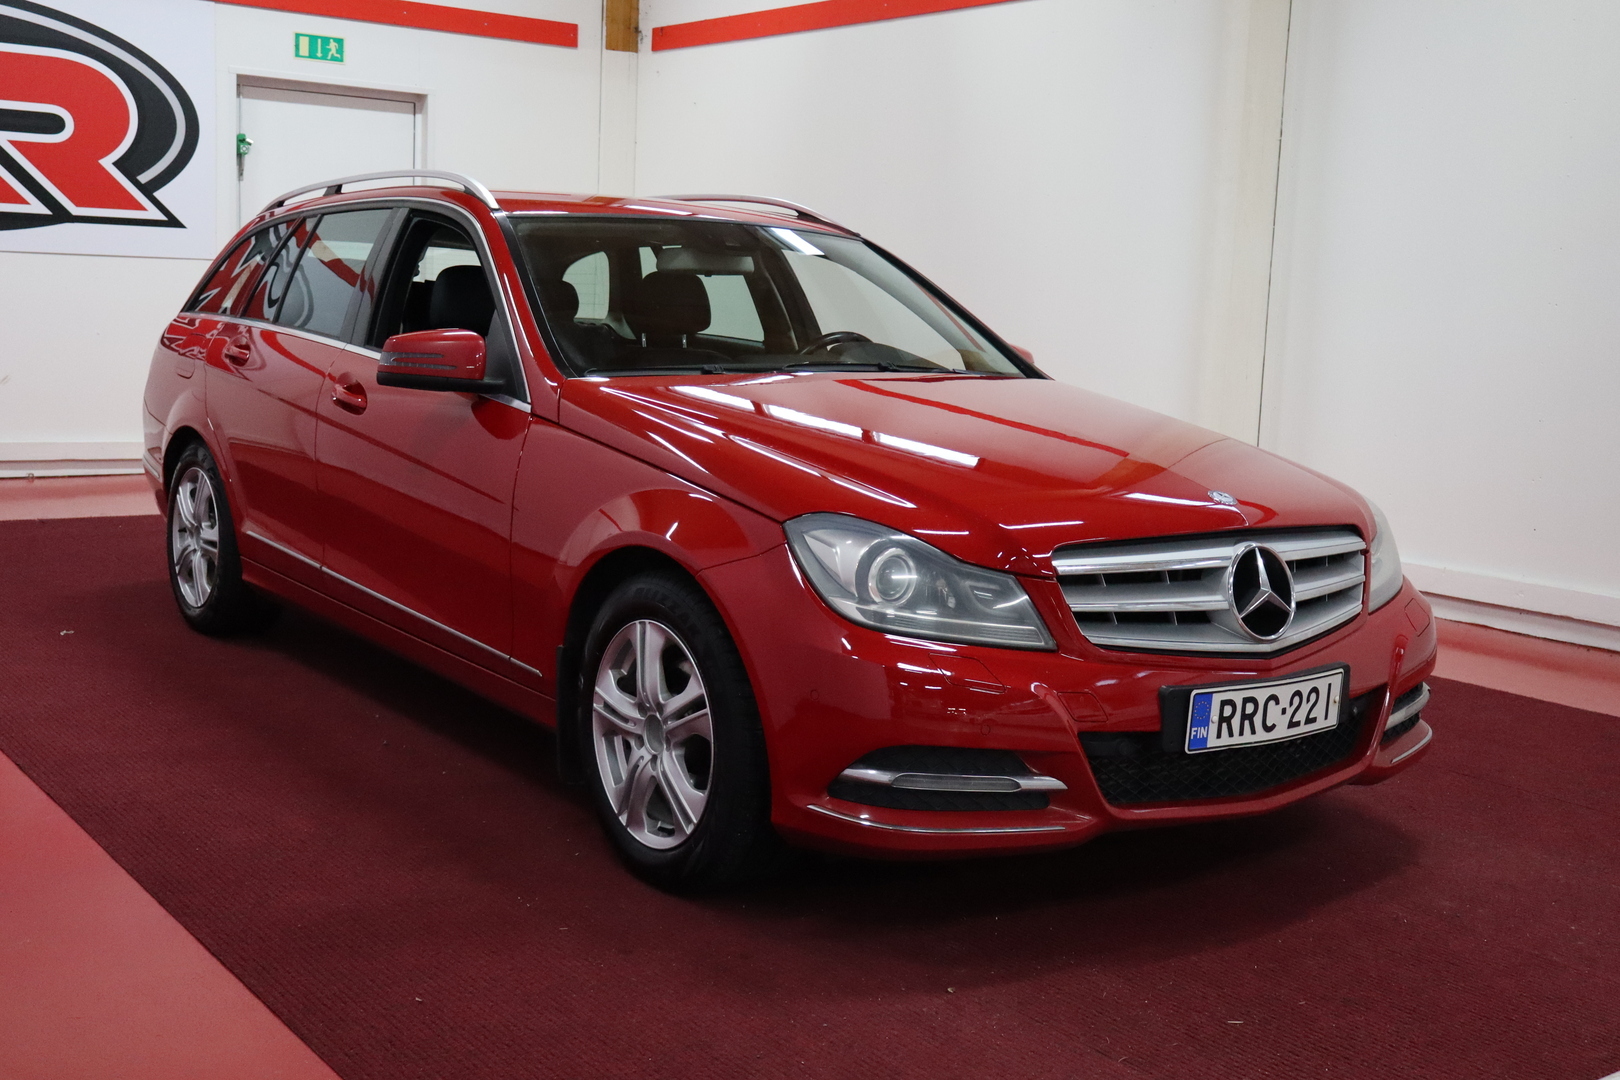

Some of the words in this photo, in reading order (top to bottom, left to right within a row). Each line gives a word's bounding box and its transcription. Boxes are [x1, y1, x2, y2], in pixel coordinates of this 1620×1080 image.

[0, 43, 169, 221] R
[1190, 726, 1208, 740] FIN
[1216, 682, 1332, 740] RRC-221
